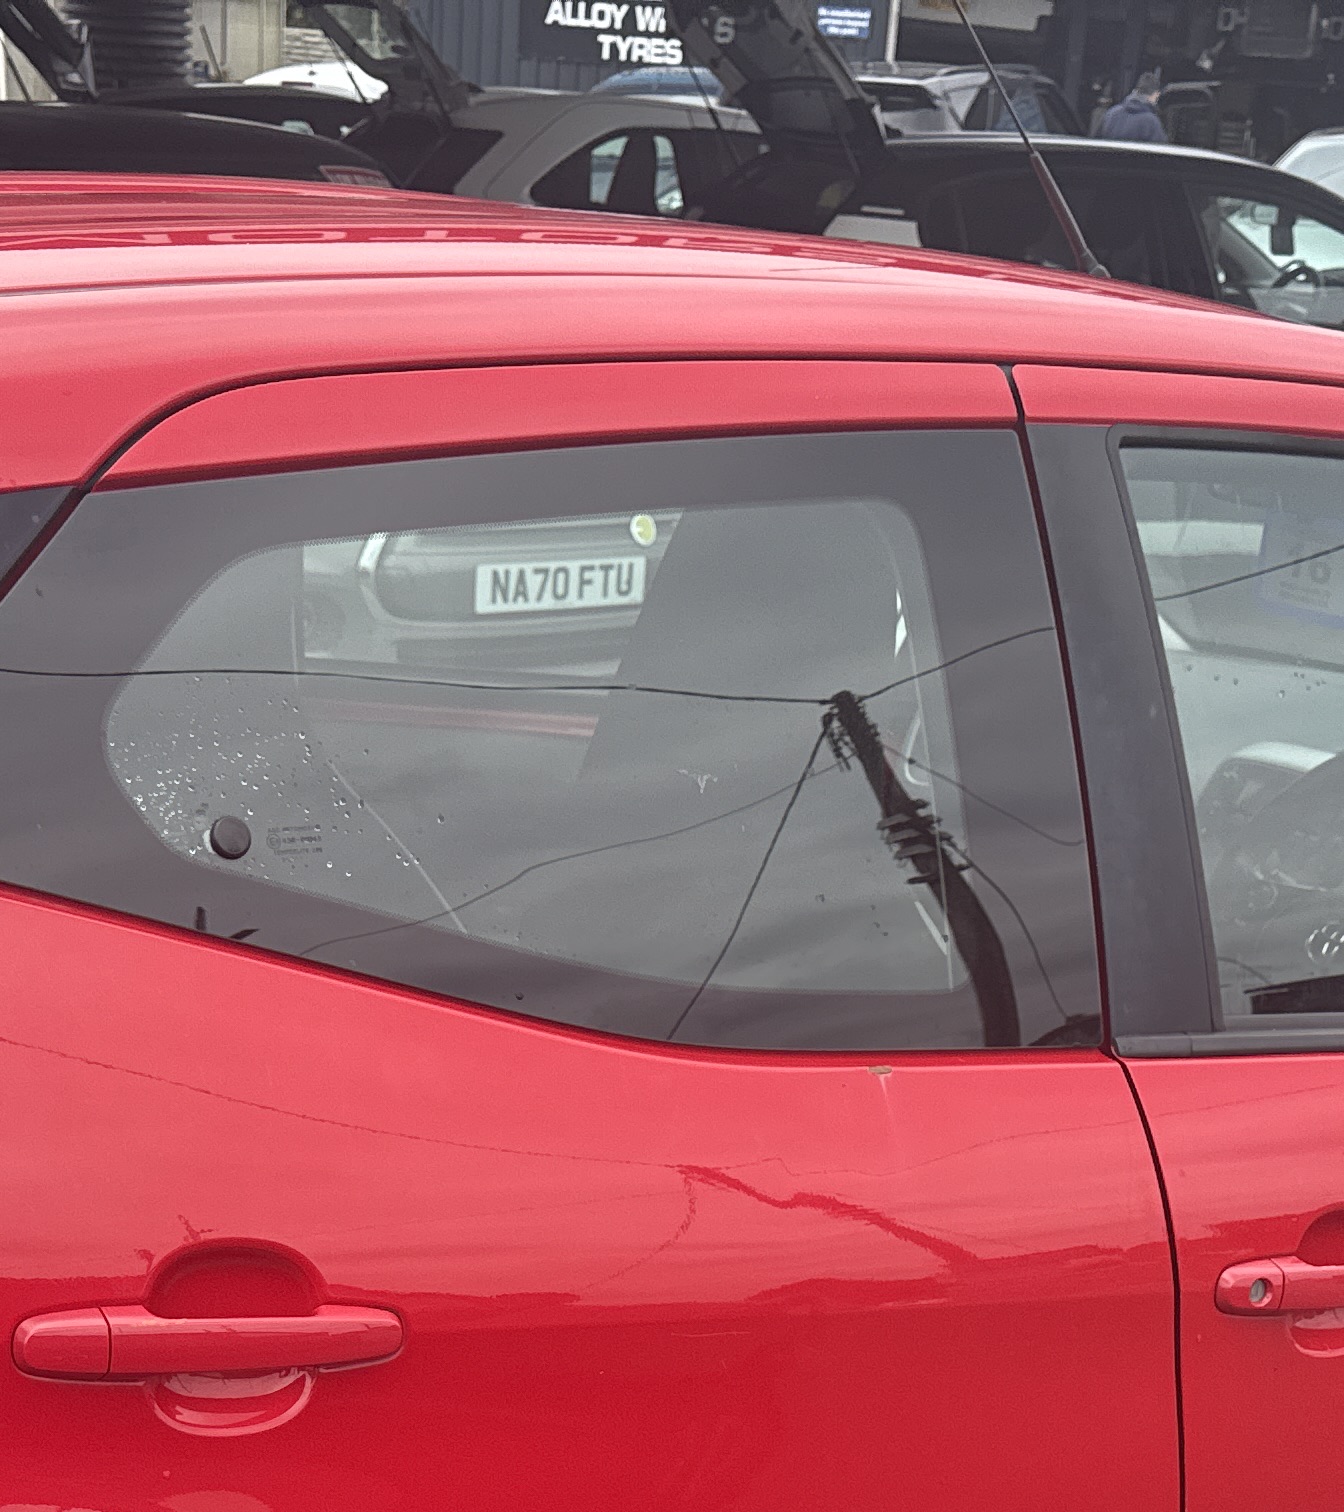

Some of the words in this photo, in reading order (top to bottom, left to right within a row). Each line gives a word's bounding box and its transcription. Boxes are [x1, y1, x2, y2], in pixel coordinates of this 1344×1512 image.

[544, 1, 630, 29] ALLOY
[596, 34, 683, 65] TYRES
[490, 566, 570, 605] NA70
[577, 562, 635, 600] FTU
